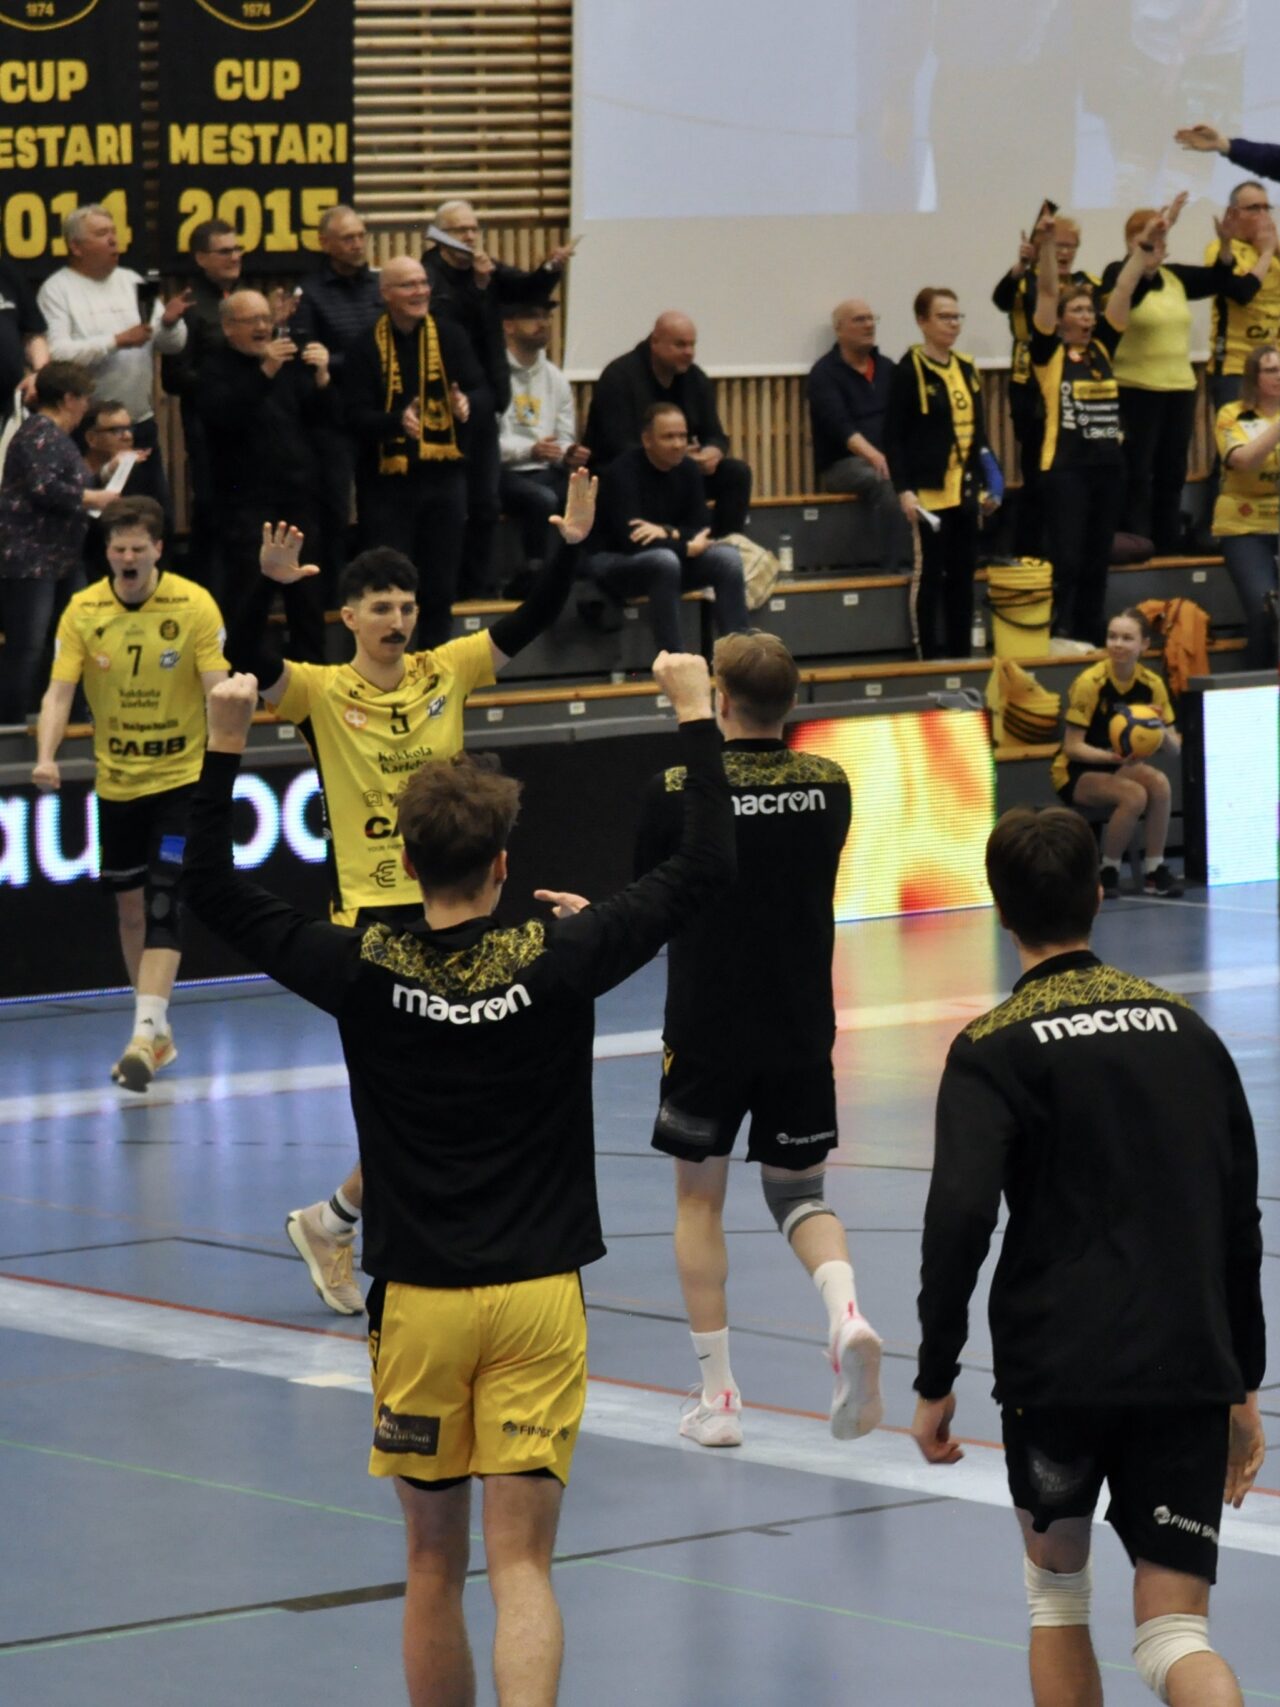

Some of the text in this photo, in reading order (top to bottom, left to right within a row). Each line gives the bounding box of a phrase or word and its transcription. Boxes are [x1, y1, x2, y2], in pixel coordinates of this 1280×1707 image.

[0, 59, 88, 103] CUP
[214, 59, 300, 101] CUP
[0, 123, 133, 169] ESTARI
[169, 123, 348, 165] MESTARI
[4, 189, 132, 259] 014
[177, 187, 339, 254] 2015
[127, 645, 142, 677] 7
[108, 736, 186, 757] CABB
[378, 746, 432, 763] Kokkola
[381, 760, 424, 774] Karleb
[393, 983, 532, 1025] macron
[1031, 1007, 1178, 1044] macron
[1170, 1514, 1201, 1534] FINN
